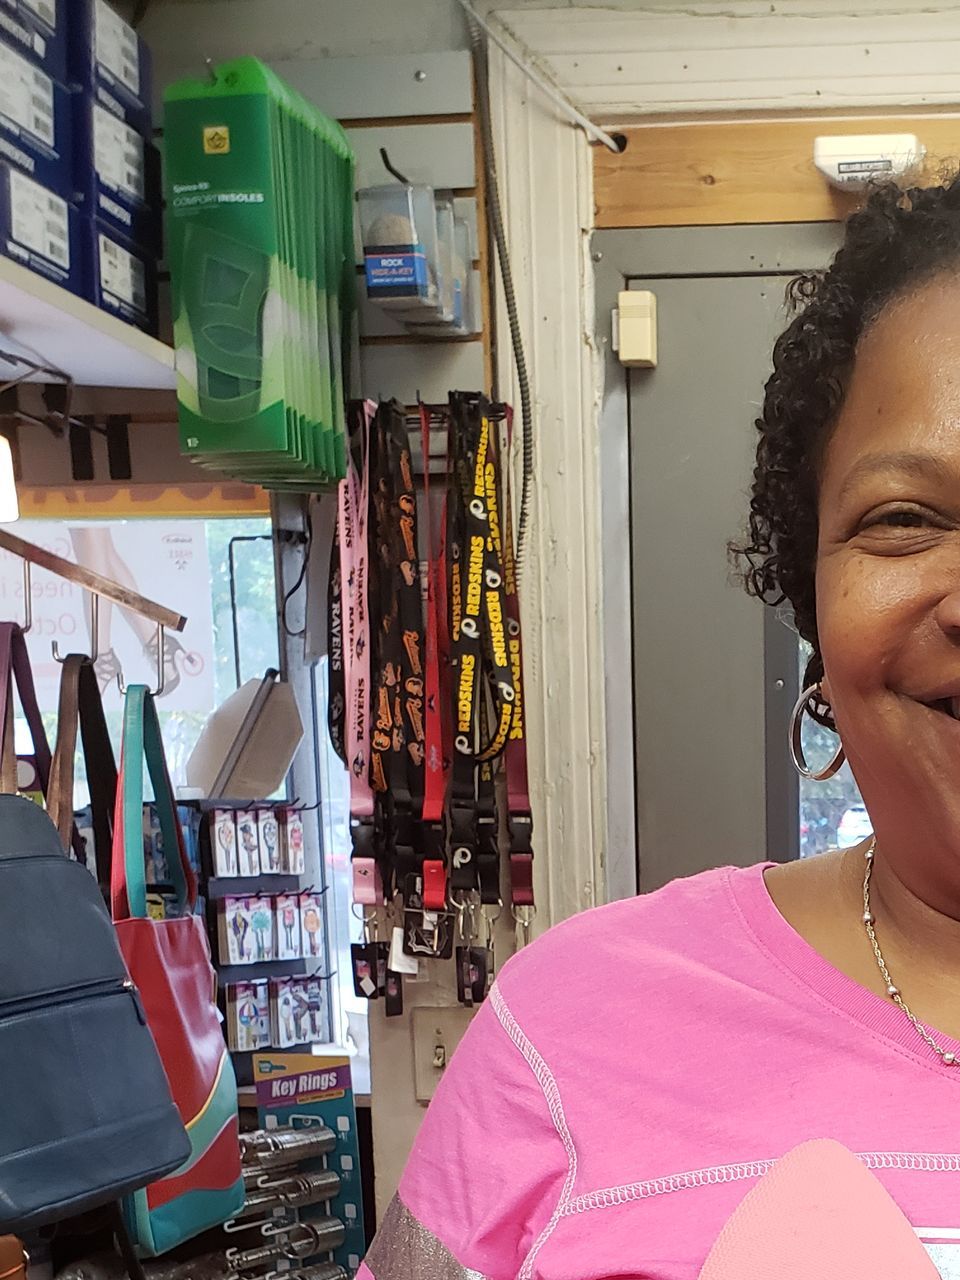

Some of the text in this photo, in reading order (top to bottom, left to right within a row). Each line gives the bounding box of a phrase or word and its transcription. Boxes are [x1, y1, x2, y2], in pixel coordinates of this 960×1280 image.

[381, 258, 403, 267] ROCK
[474, 416, 489, 497] REDSKINS
[466, 536, 485, 616] REDSKINS
[332, 602, 342, 671] RAVENS
[486, 591, 508, 668] REDSKINS
[357, 678, 365, 742] RAVENS
[458, 654, 476, 733] REDSKINS
[271, 1078, 297, 1098] Key
[299, 1071, 337, 1093] Rings
